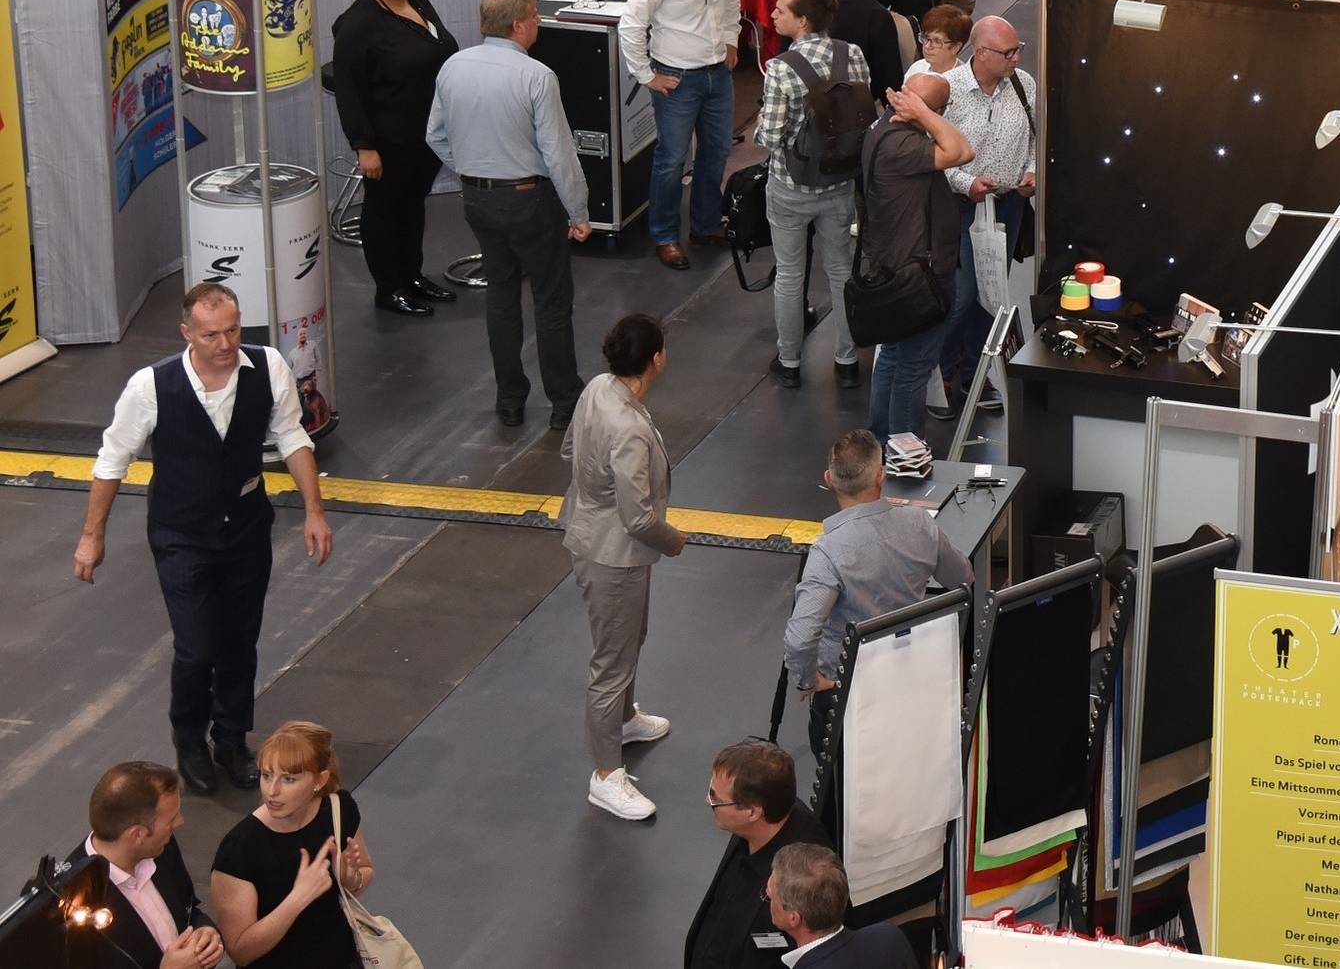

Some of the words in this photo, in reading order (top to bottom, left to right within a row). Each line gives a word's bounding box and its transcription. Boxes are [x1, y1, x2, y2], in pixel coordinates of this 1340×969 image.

[194, 24, 222, 37] The
[181, 33, 250, 55] Addams
[185, 51, 246, 82] Family
[1243, 684, 1322, 699] THEATER
[1243, 692, 1322, 708] POETENPACK
[1275, 755, 1294, 767] Das
[1298, 758, 1326, 771] Spiel
[1251, 777, 1275, 789] Eine
[1277, 830, 1305, 843] Pippi
[1308, 834, 1326, 844] auf
[1307, 907, 1340, 920] Unter
[1285, 930, 1306, 941] Der
[1284, 954, 1310, 966] Gift.
[1313, 957, 1337, 968] Eine
